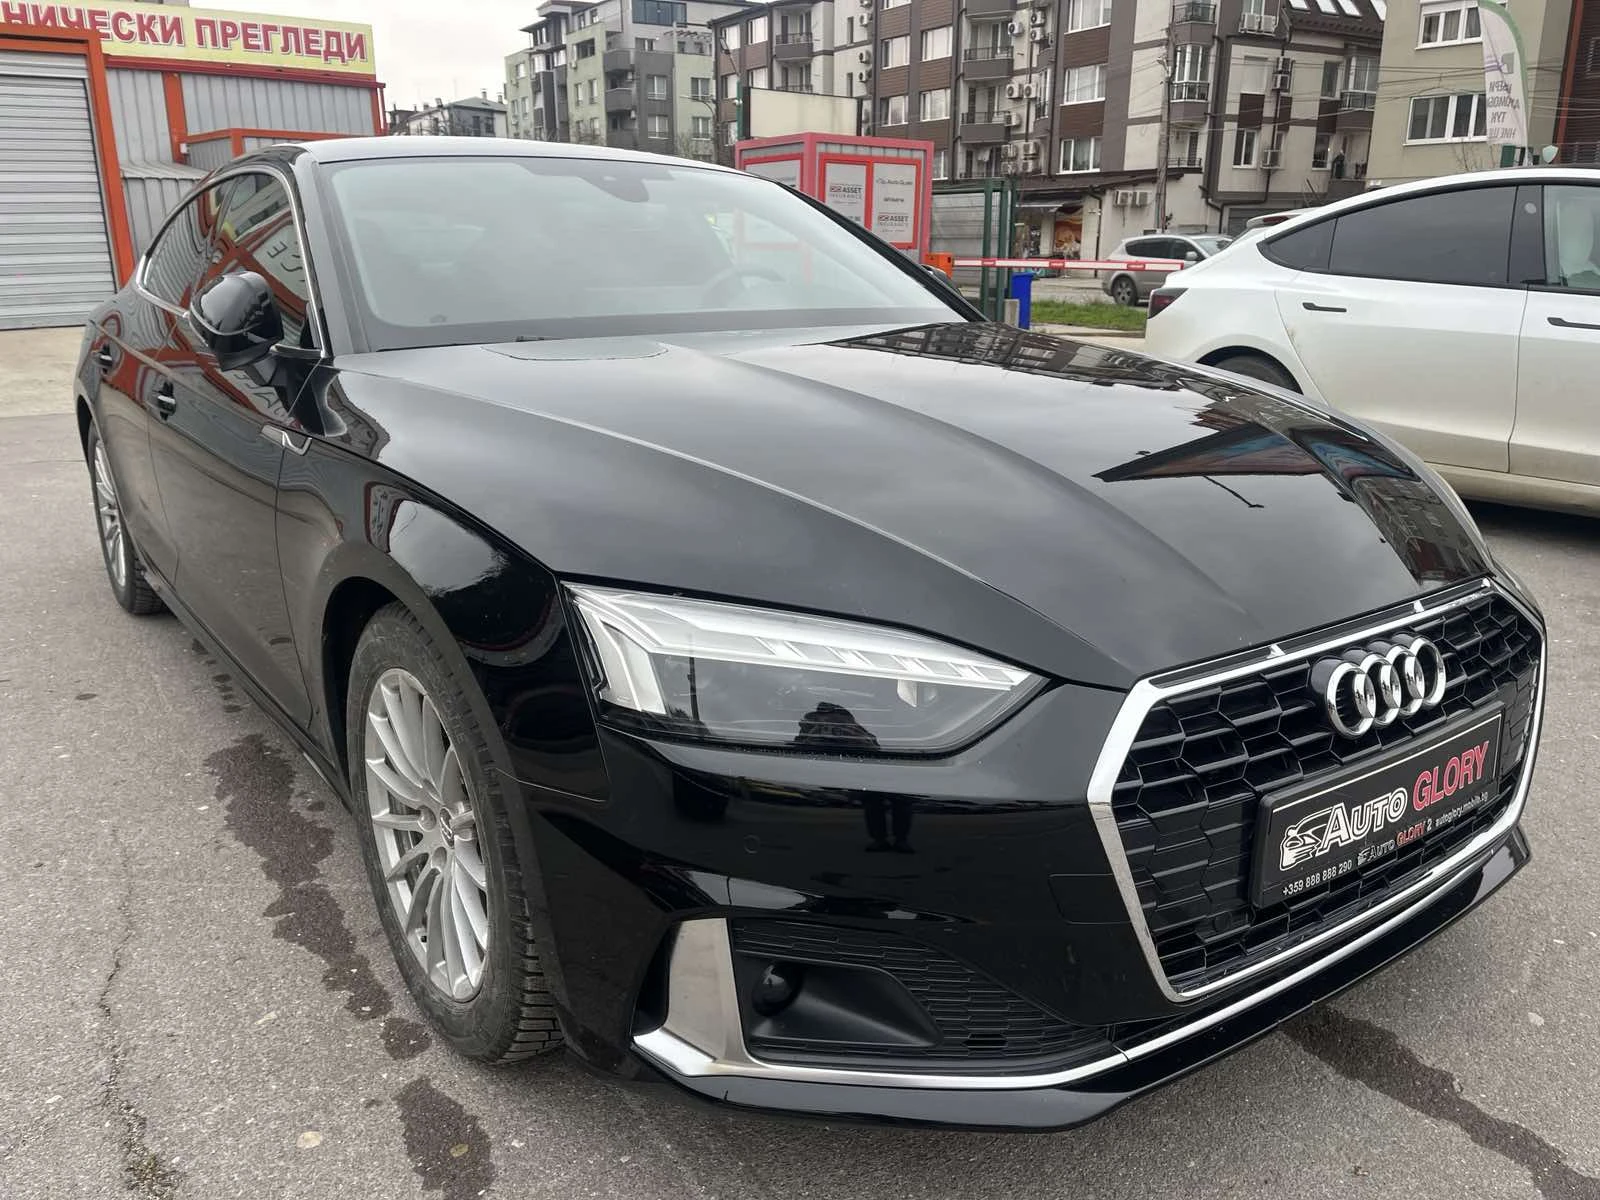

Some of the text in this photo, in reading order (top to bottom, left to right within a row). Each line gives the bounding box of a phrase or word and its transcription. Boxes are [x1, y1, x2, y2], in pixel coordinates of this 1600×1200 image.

[195, 18, 367, 64] ПРЕГЛЕДИ
[842, 186, 862, 194] ASSET
[1412, 740, 1490, 811] GLORY
[1282, 879, 1304, 896] +359
[1305, 872, 1321, 888] 888
[1322, 865, 1337, 881] 888
[1338, 859, 1353, 875] 290
[1396, 820, 1425, 847] GLORY
